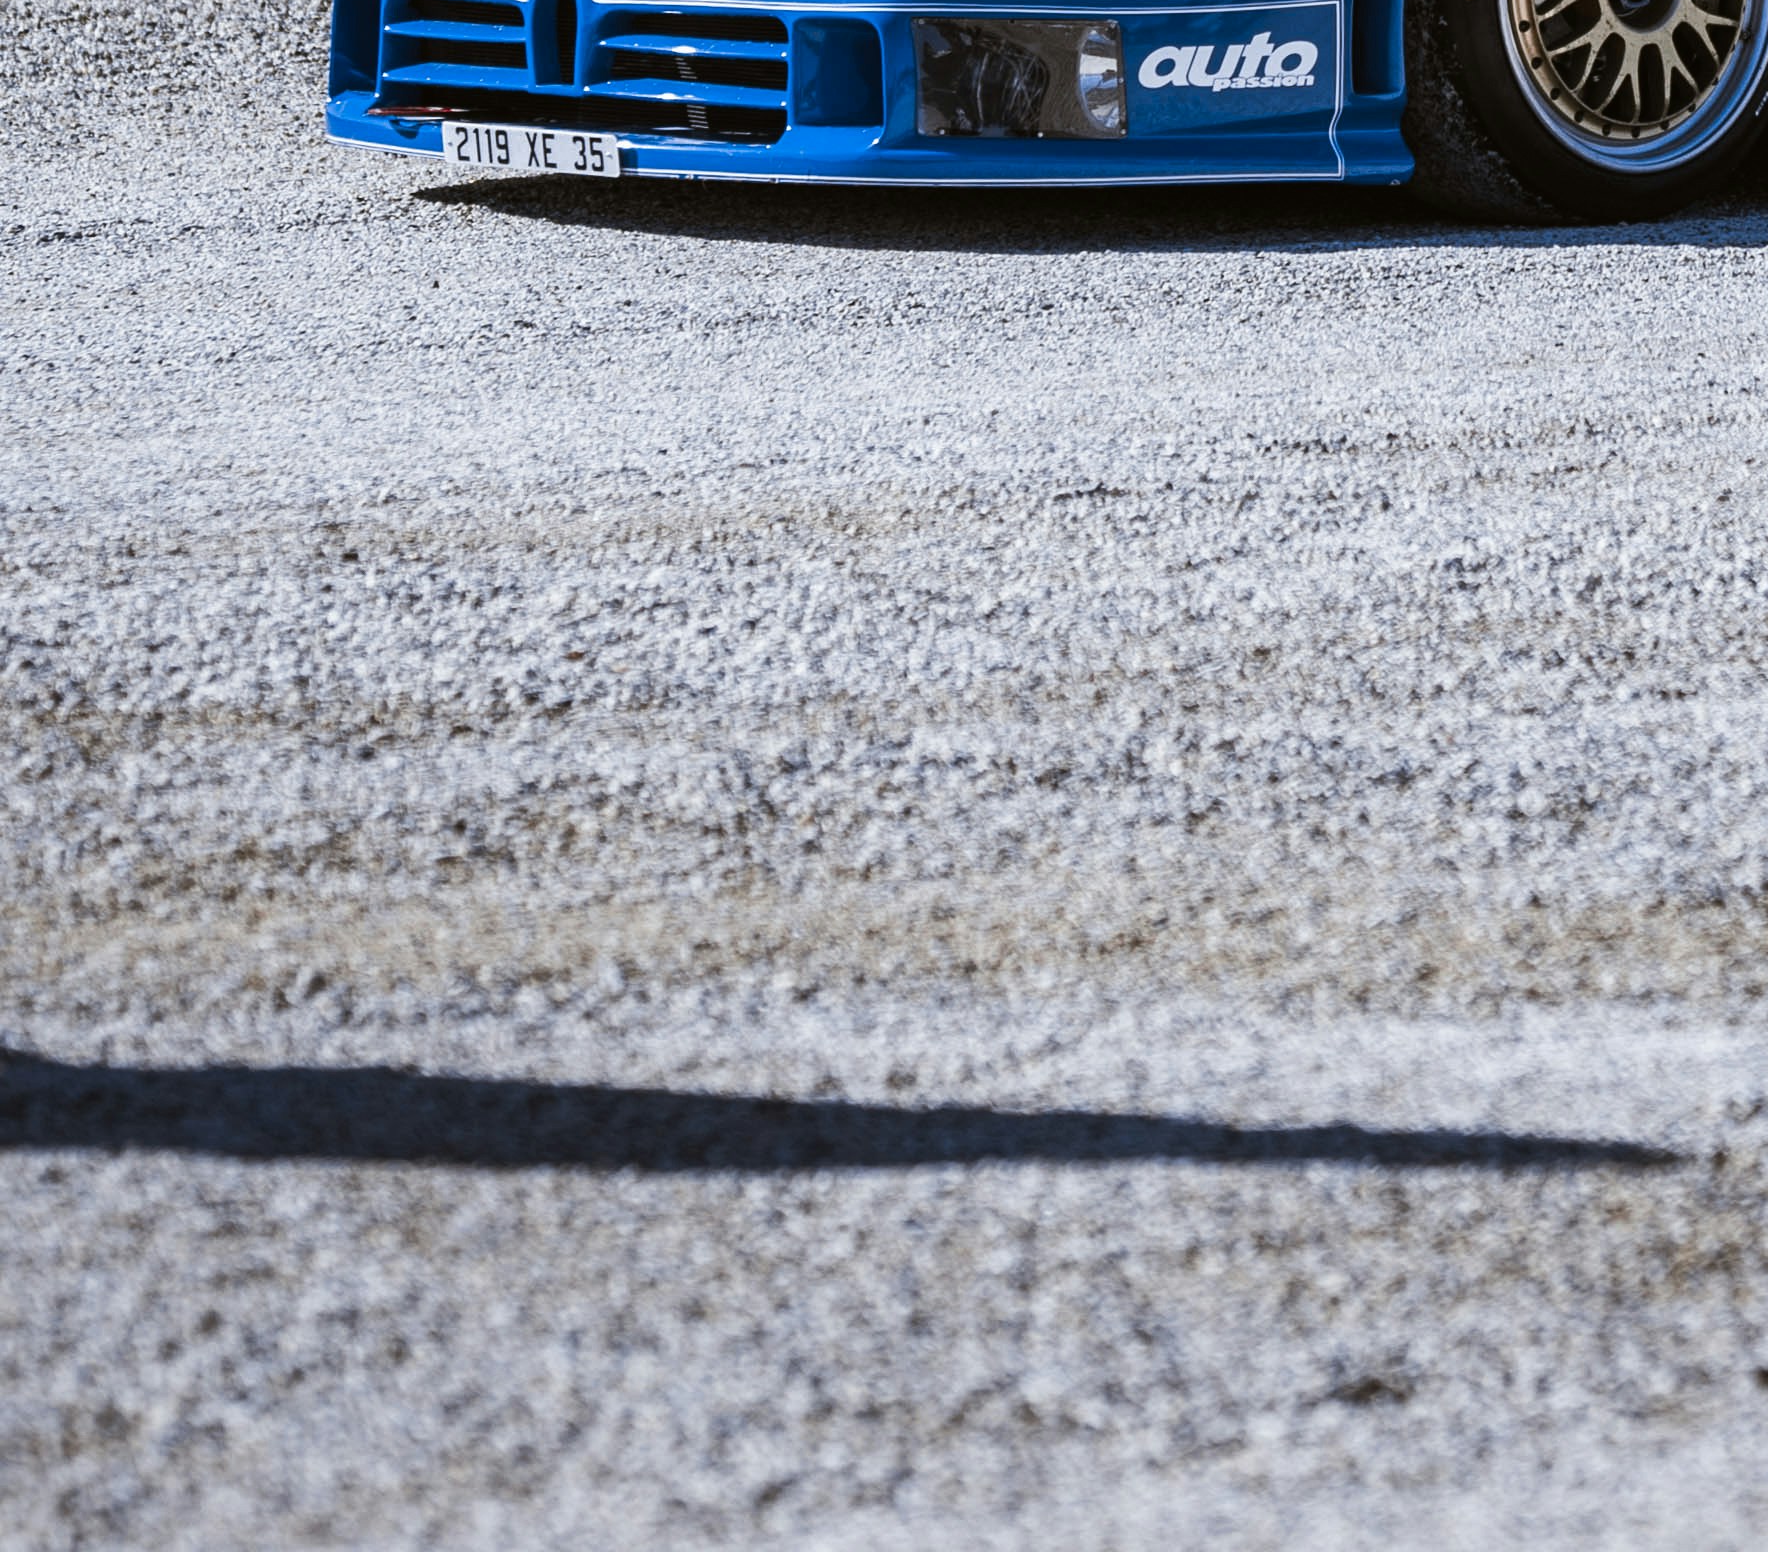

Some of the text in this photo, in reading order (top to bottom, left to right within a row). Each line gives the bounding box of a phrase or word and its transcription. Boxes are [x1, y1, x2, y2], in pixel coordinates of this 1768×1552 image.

[1138, 31, 1319, 89] auto
[1212, 73, 1315, 93] passion
[455, 126, 605, 173] 2119 XE 35
